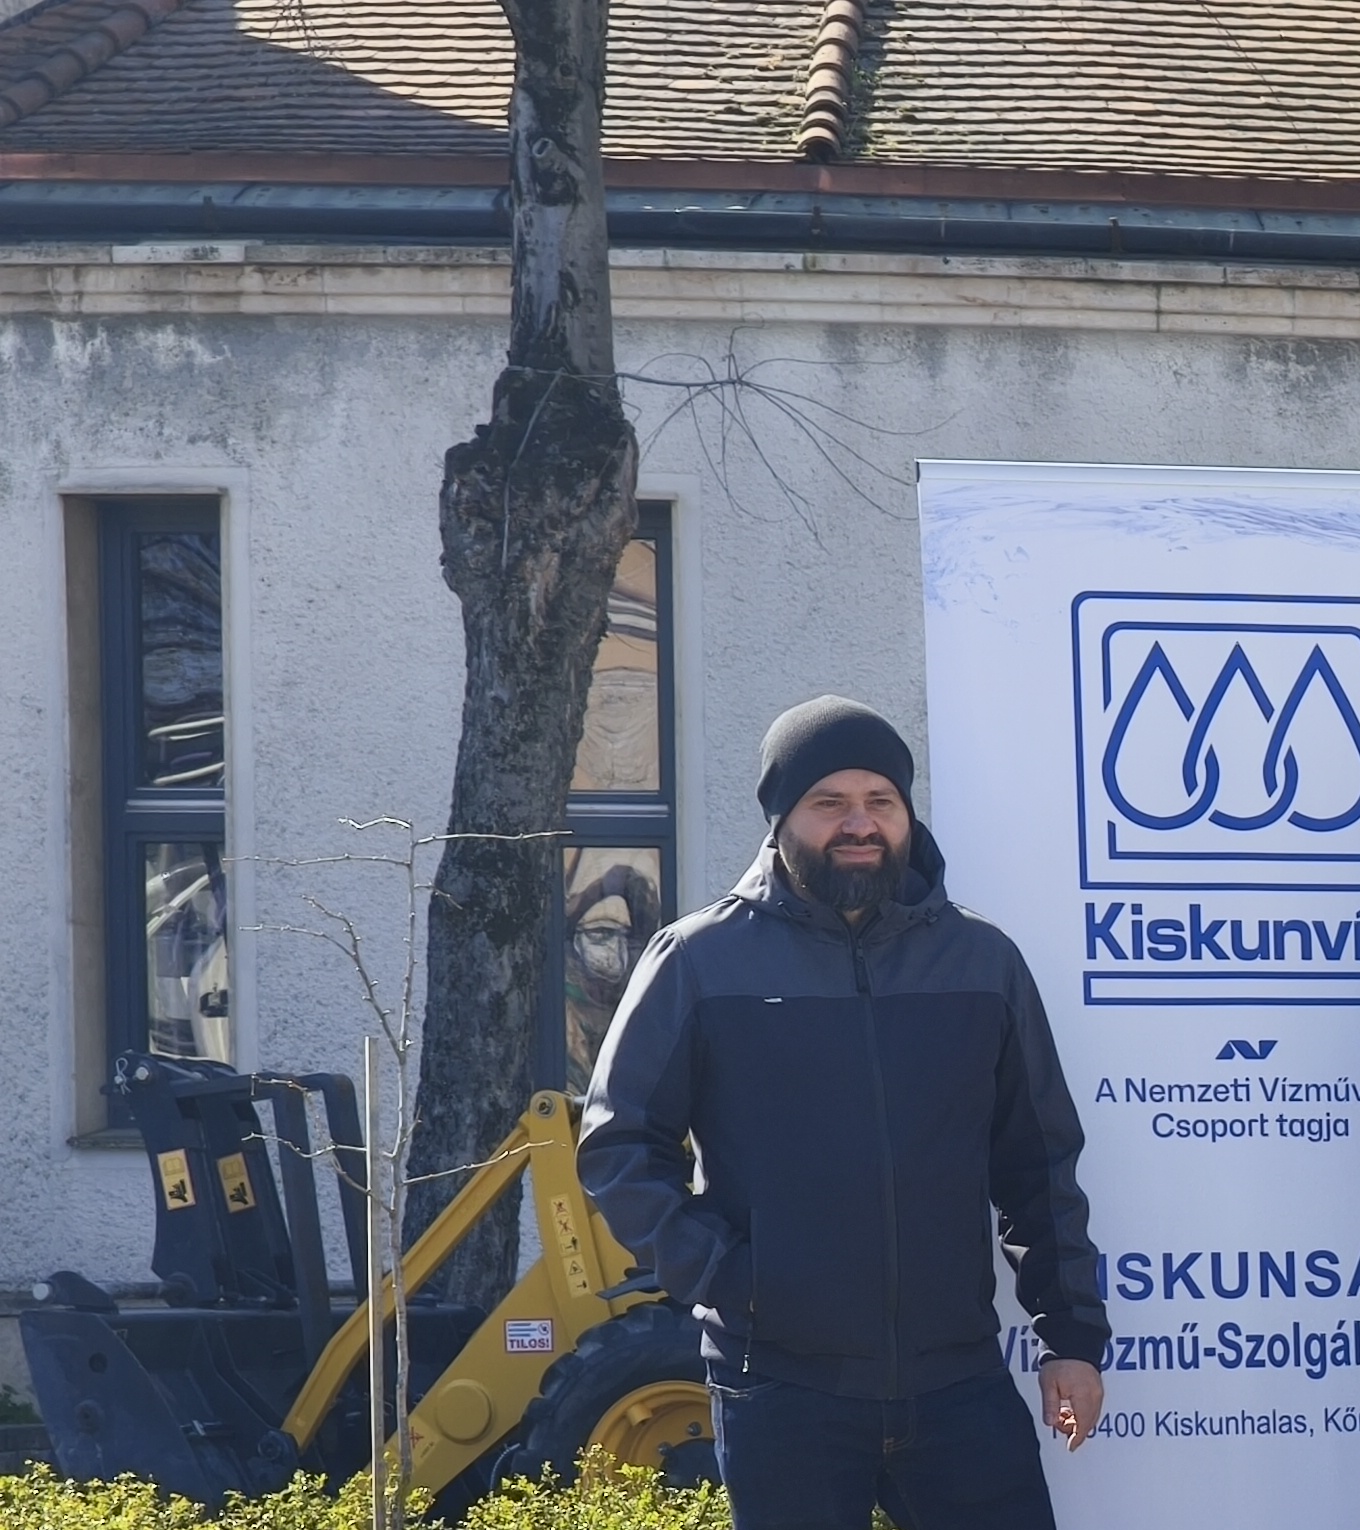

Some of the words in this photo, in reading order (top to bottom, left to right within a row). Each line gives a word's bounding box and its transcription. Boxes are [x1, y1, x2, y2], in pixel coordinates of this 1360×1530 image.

[1095, 1078, 1117, 1103] A
[1125, 1077, 1250, 1103] Nemzeti
[1152, 1113, 1269, 1142] Csoport
[1275, 1113, 1350, 1142] tagja
[509, 1338, 550, 1349] TILOS!
[1154, 1407, 1315, 1438] Kiskunhalas,
